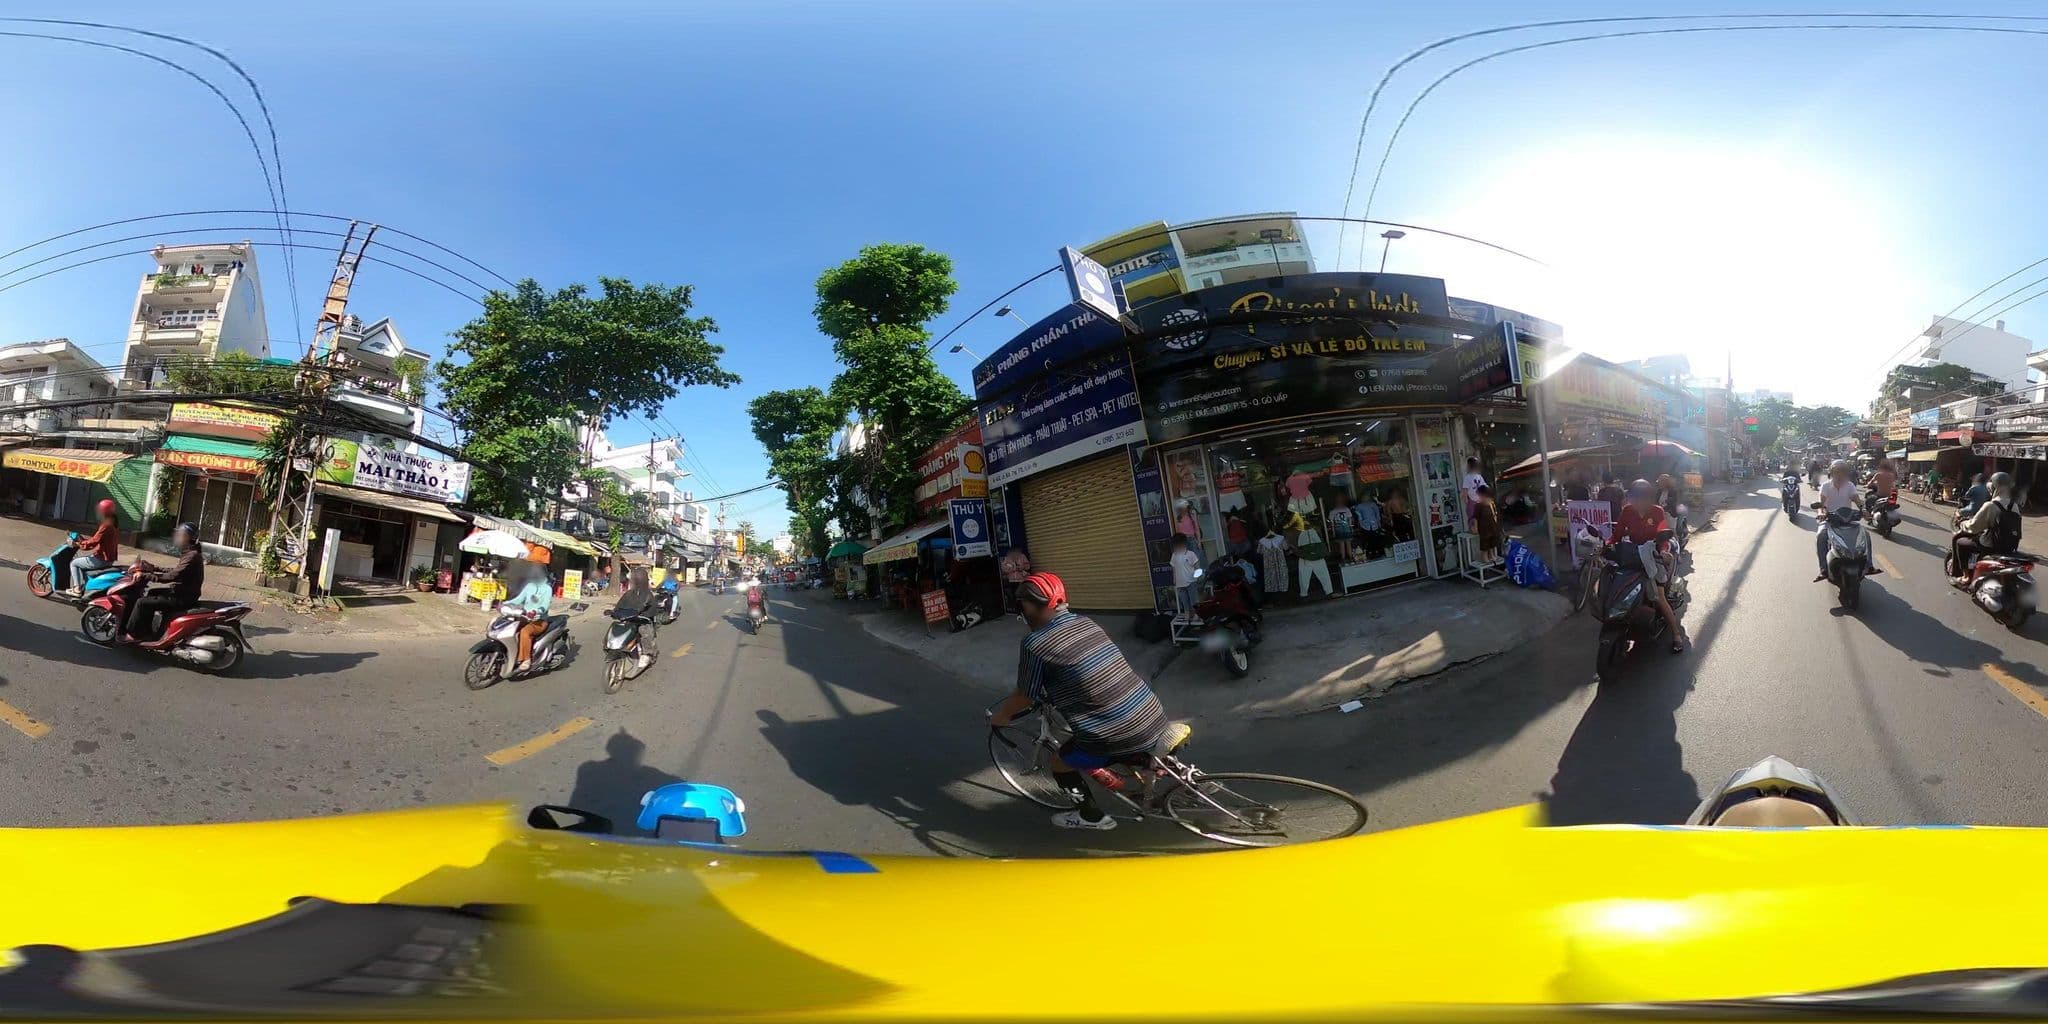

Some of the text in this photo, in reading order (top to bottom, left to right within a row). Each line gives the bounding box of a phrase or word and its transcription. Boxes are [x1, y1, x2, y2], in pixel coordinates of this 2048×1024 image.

[997, 347, 1029, 374] PHÒNG
[1031, 324, 1068, 352] KHÁM
[1072, 411, 1084, 427] PET
[1085, 406, 1099, 421] SPA
[1102, 399, 1115, 416] PET
[1117, 391, 1140, 411] HOTEL
[21, 458, 55, 470] TOMYUM
[384, 451, 433, 470] NHÀ THUỐC
[359, 461, 391, 479] MAI
[395, 468, 438, 488] THẢO
[952, 501, 983, 515] THÚ Y
